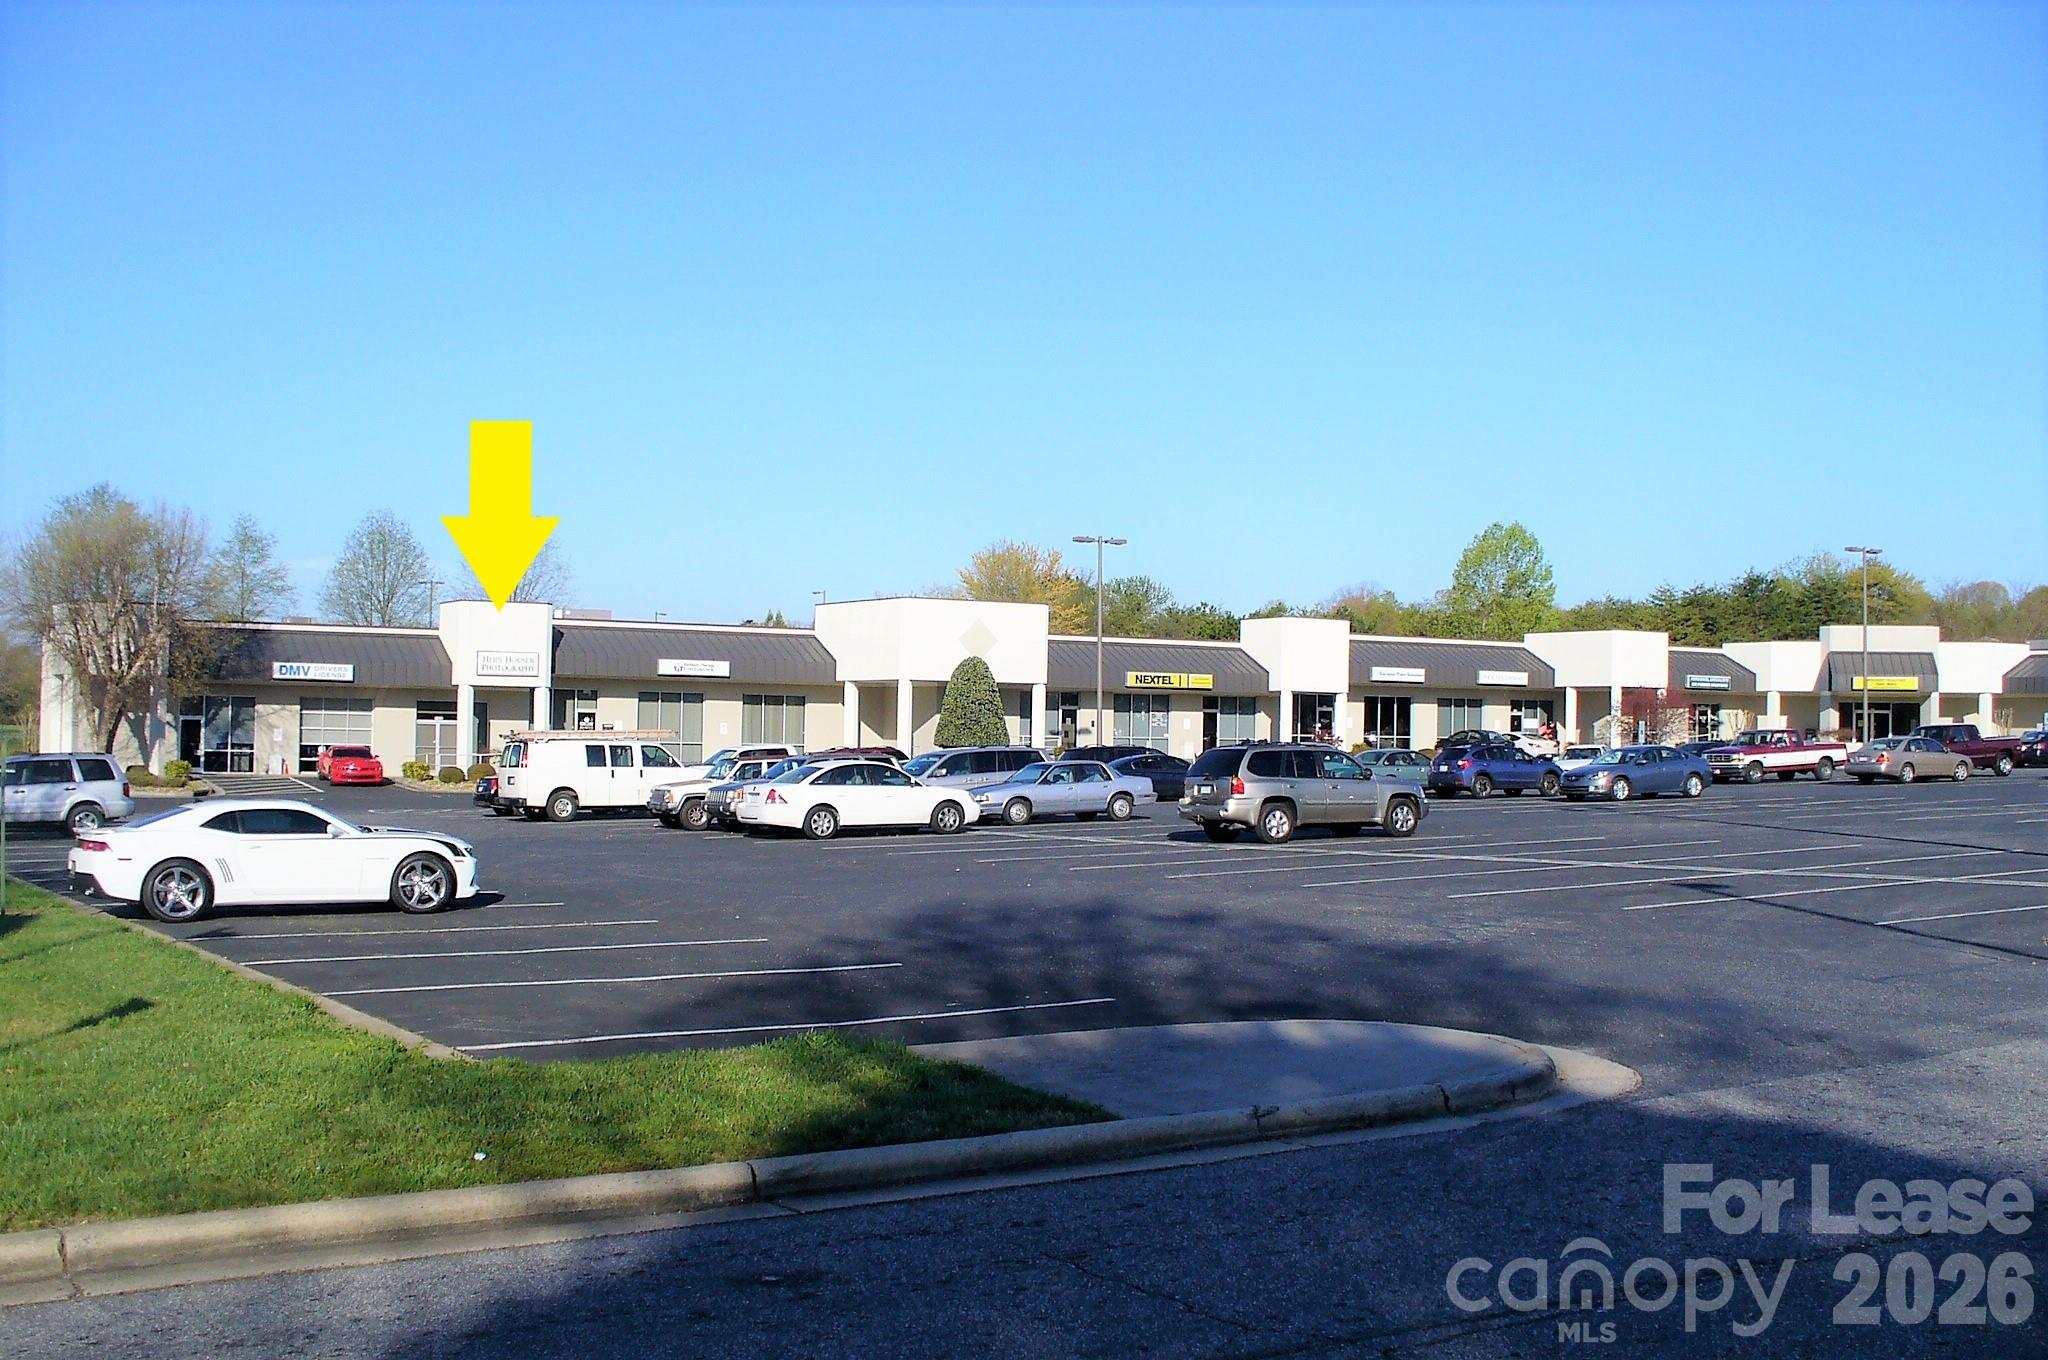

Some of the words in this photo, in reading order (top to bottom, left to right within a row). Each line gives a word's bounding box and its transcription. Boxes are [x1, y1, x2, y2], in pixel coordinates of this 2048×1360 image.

[279, 664, 311, 676] DMV
[481, 663, 535, 672] PHOTOGRAPHY
[1135, 674, 1174, 685] NEXTEL
